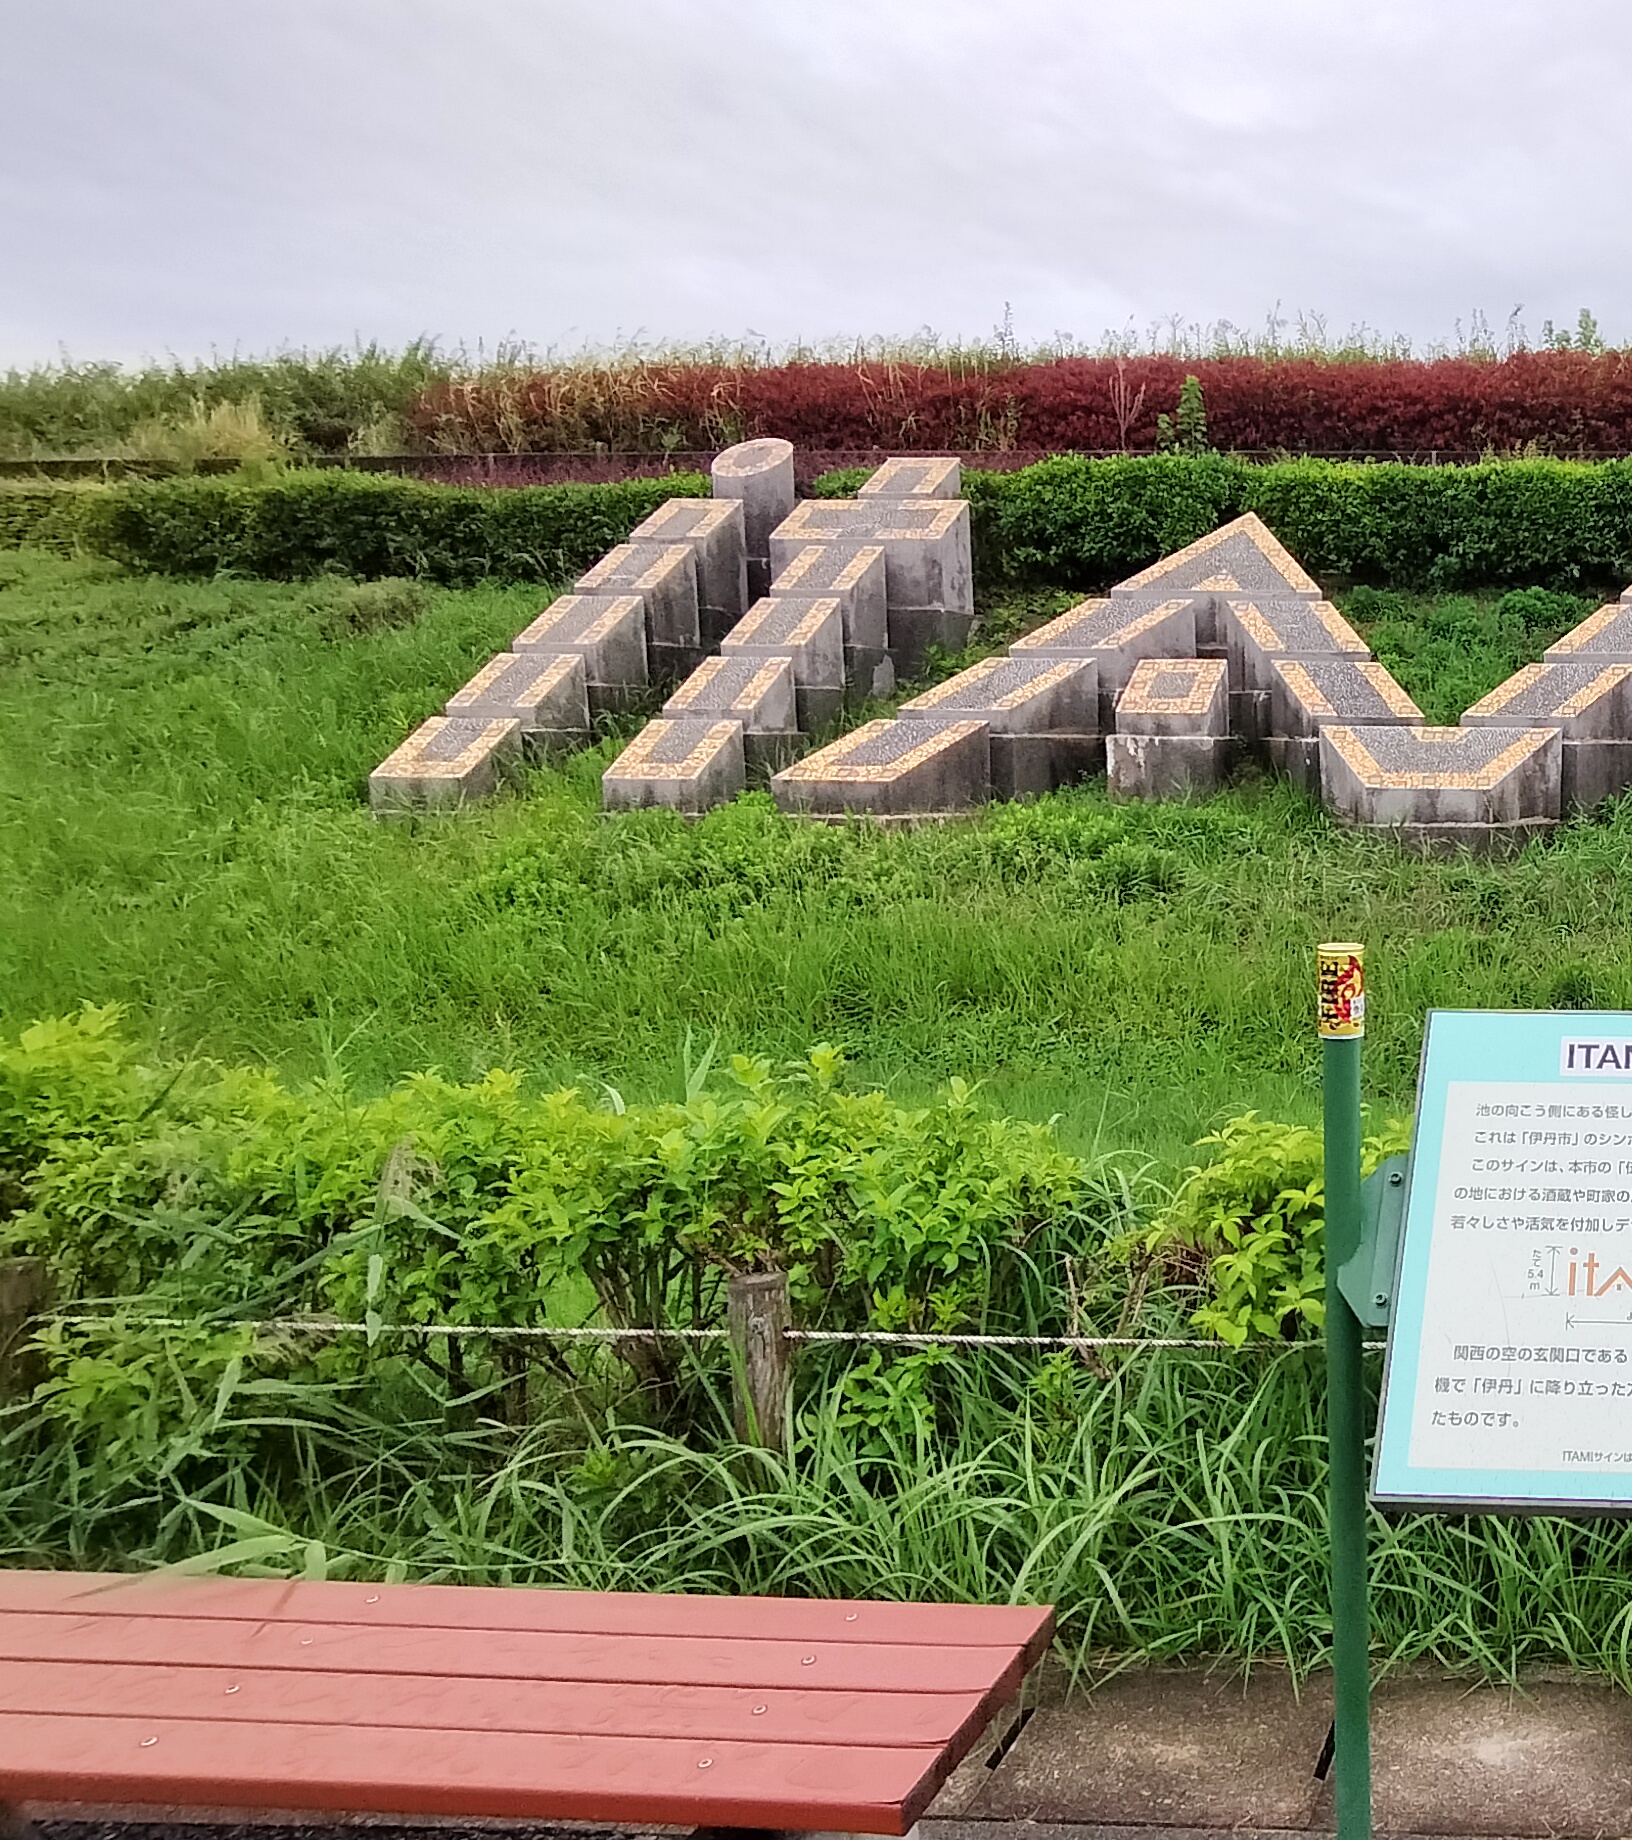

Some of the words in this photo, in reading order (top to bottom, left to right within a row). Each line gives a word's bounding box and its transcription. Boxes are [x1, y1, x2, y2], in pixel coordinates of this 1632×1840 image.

[1431, 1410, 1520, 1428] たものです。
